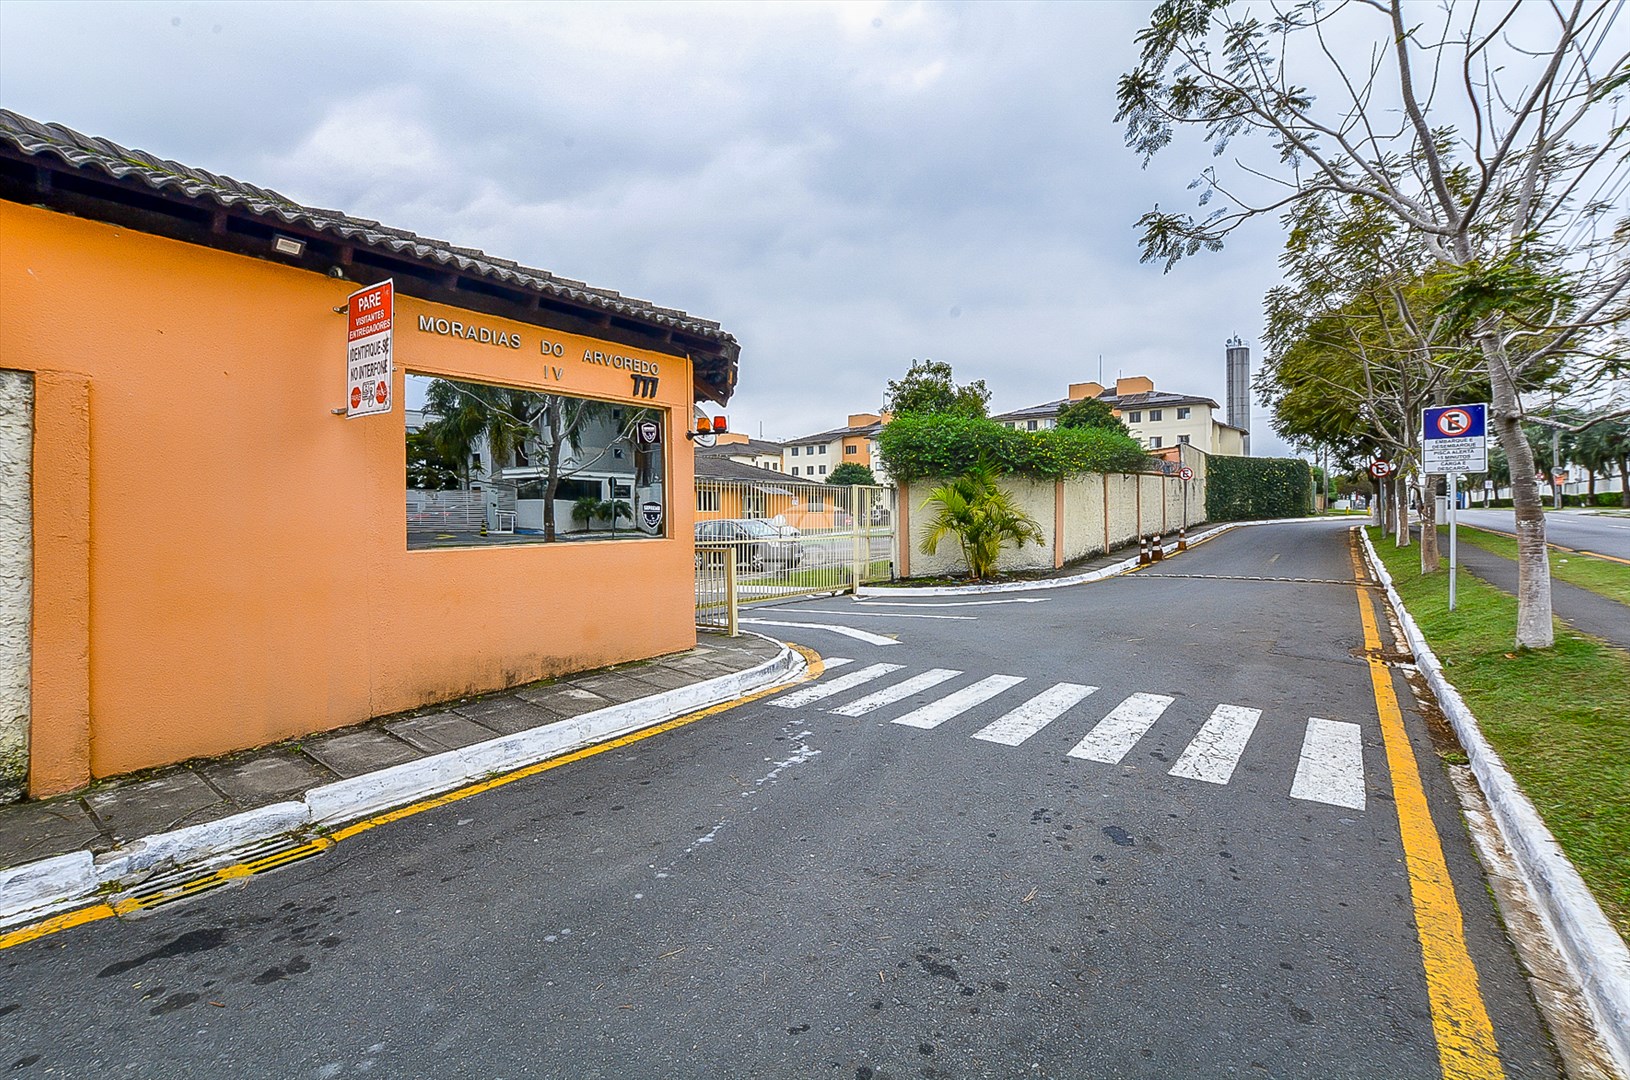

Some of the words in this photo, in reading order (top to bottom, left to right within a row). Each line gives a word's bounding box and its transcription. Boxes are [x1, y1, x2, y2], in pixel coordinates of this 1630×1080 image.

[358, 291, 382, 312] PARE
[349, 318, 391, 340] ENTREGADORES
[355, 309, 385, 326] VISITANTES
[350, 337, 389, 362] IDENTIFIQUE-SE
[419, 315, 521, 349] MORADIAS
[541, 340, 565, 357] DO
[582, 349, 660, 376] ARVOREDO
[350, 367, 359, 382] NO
[359, 359, 388, 380] INTERFONE
[630, 374, 660, 399] 777
